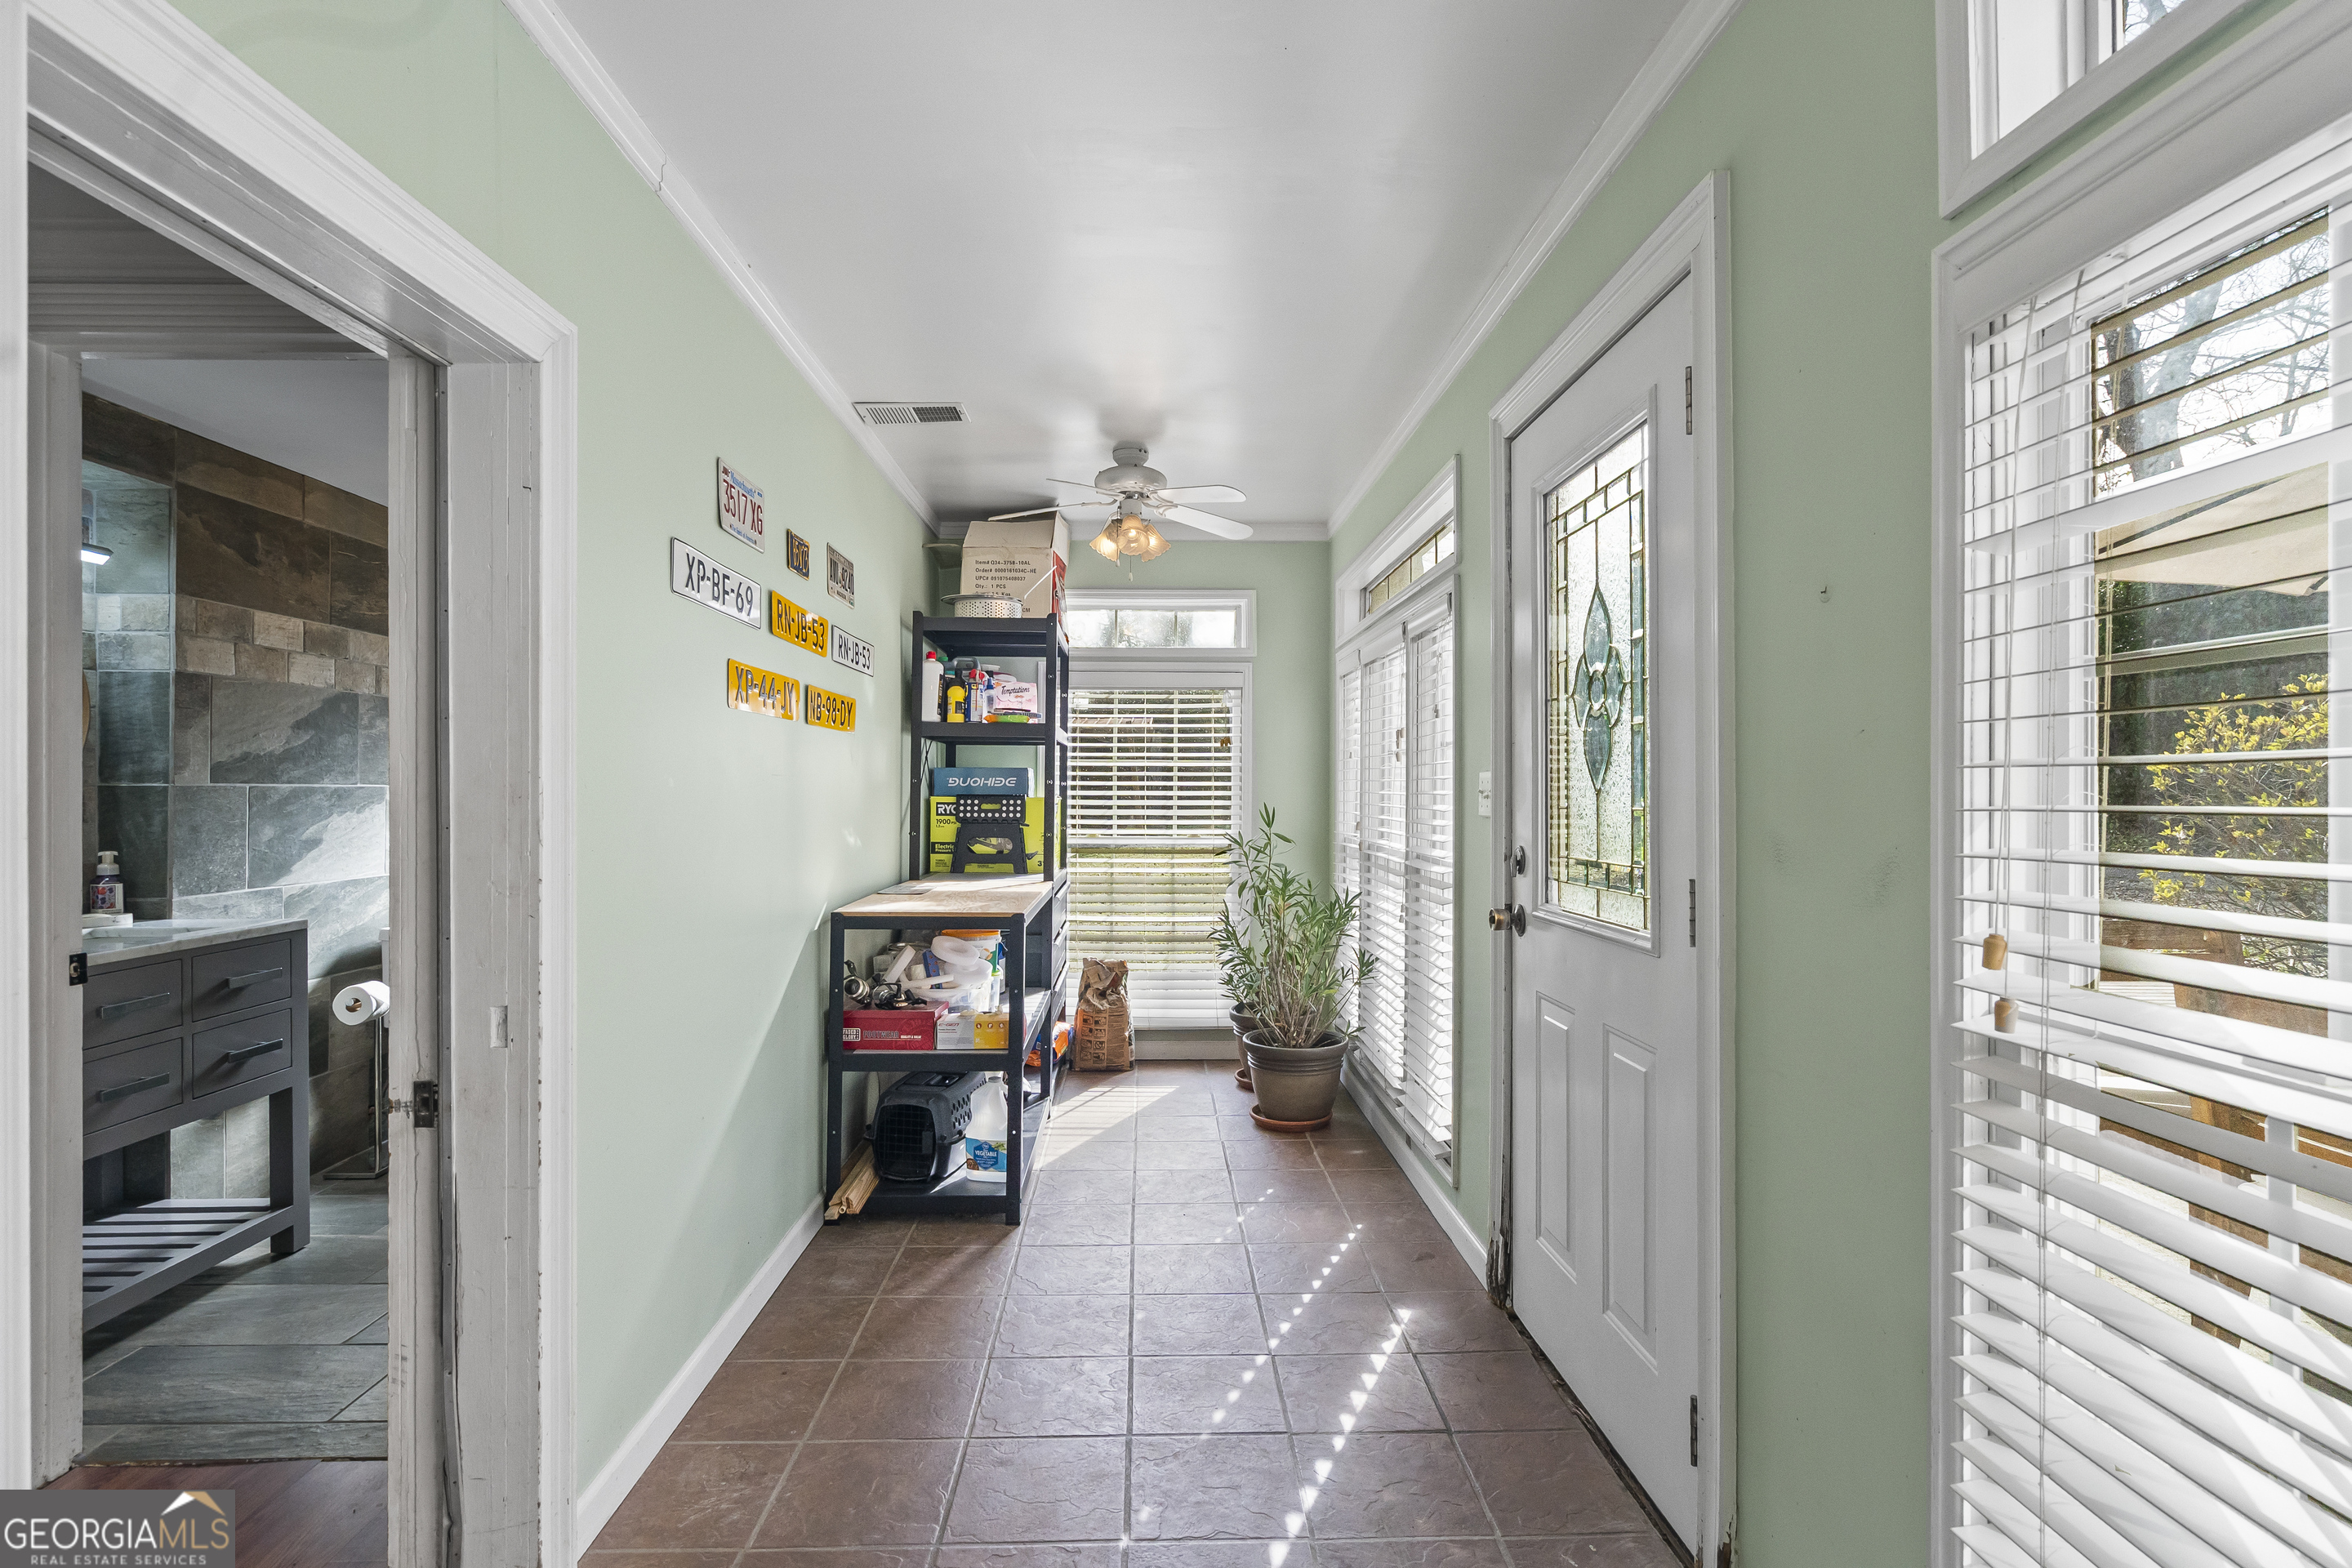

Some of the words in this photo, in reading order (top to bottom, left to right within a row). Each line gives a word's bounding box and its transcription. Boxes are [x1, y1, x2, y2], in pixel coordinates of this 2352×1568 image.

[730, 470, 755, 499] Massachusetts
[723, 479, 747, 525] 3517
[750, 499, 763, 536] XG
[684, 552, 754, 617] XP-BF-69
[777, 599, 825, 651] RN-JB-53
[838, 634, 871, 670] RN-JB-53
[735, 666, 795, 714] XP-44-JY
[1001, 685, 1030, 697] Temptations
[809, 690, 853, 728] NB-98-DY
[947, 777, 1017, 786] DUOHIDE
[863, 1030, 899, 1038] FOOTWEAR
